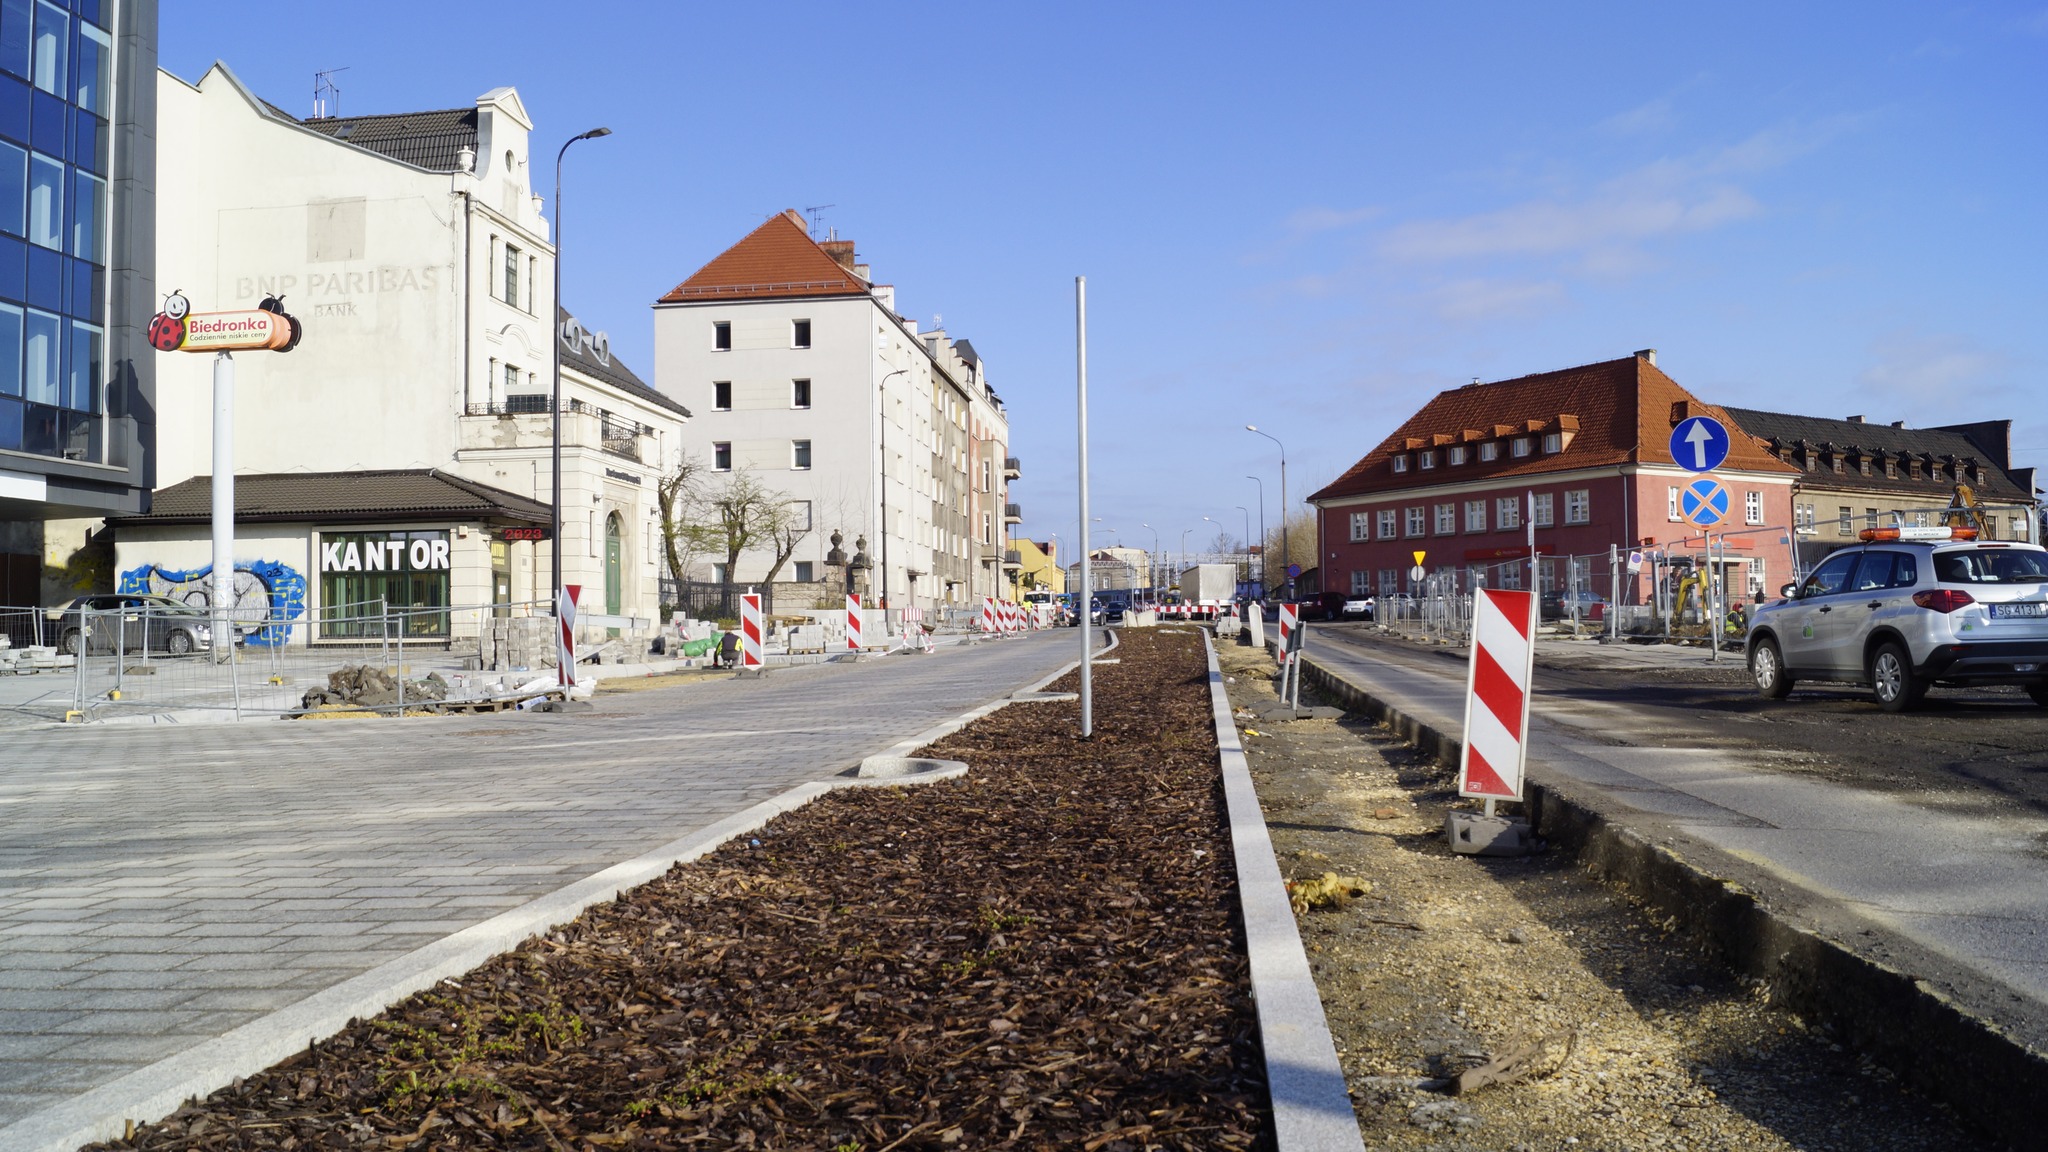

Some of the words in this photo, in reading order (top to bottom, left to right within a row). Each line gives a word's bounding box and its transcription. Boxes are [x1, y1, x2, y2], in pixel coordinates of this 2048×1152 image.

[236, 274, 297, 300] BNP
[307, 266, 438, 297] PARIBAS
[314, 302, 357, 318] BANK
[190, 317, 267, 334] Biedronka
[189, 333, 227, 342] Codziennie
[229, 331, 249, 340] niskie
[504, 528, 543, 540] 2023
[322, 539, 450, 572] KANTOR
[1997, 604, 2011, 616] SG
